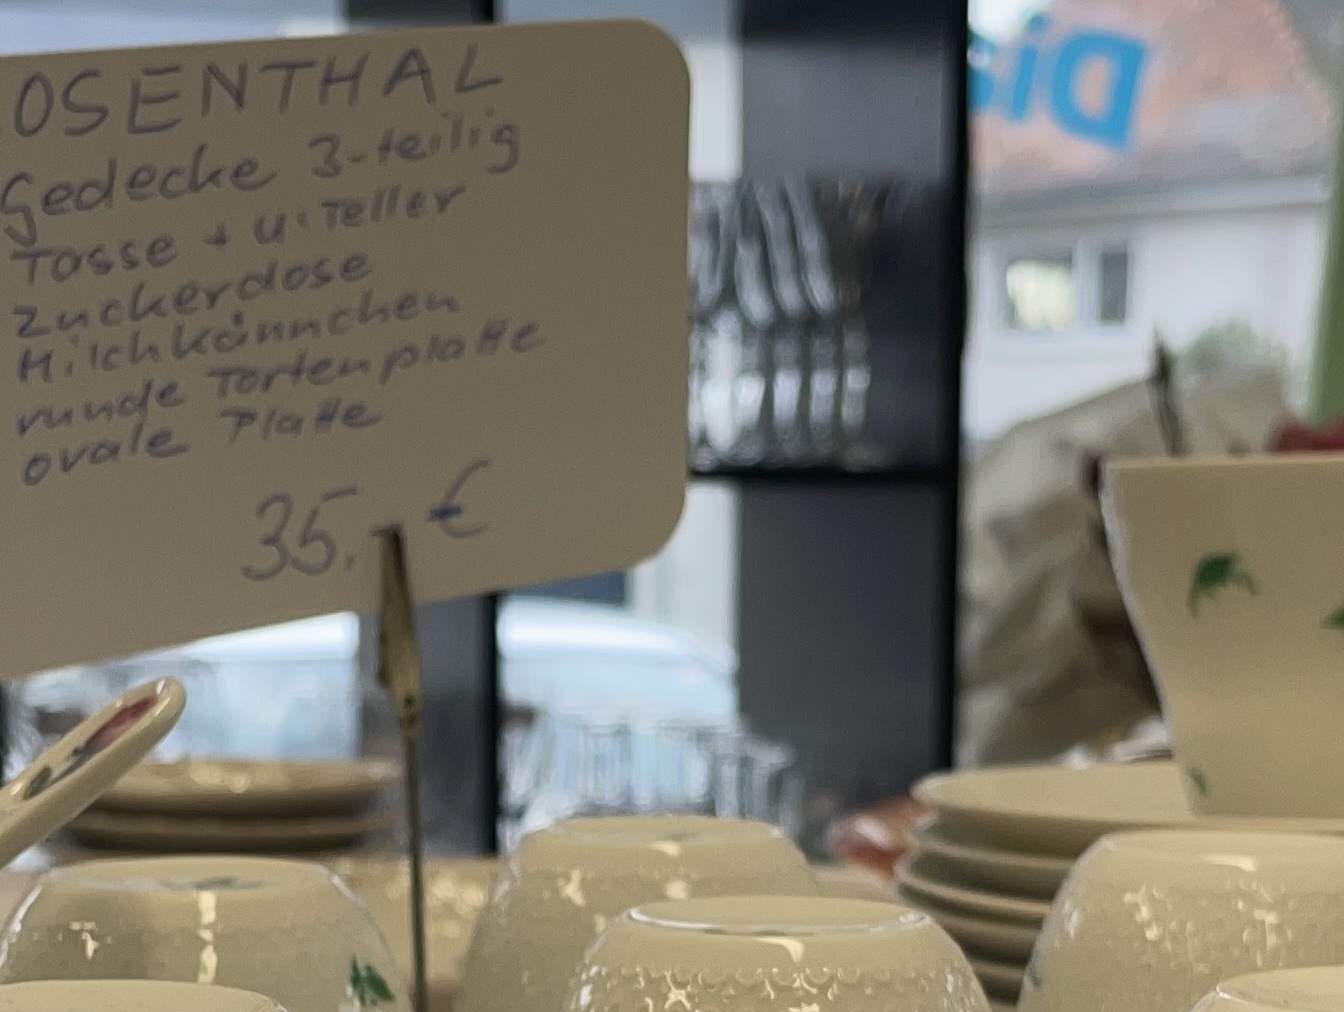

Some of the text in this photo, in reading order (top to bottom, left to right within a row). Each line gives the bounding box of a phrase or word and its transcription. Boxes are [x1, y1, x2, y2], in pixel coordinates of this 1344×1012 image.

[0, 143, 278, 248] Gedecke
[308, 108, 521, 178] 3-teilig
[10, 234, 177, 285] Tasse
[12, 253, 373, 339] Zuckerdose
[17, 378, 186, 437] runde
[207, 318, 545, 398] Tortenplatte
[22, 422, 190, 486] ovale
[219, 398, 383, 443] Platte
[426, 456, 492, 539] €
